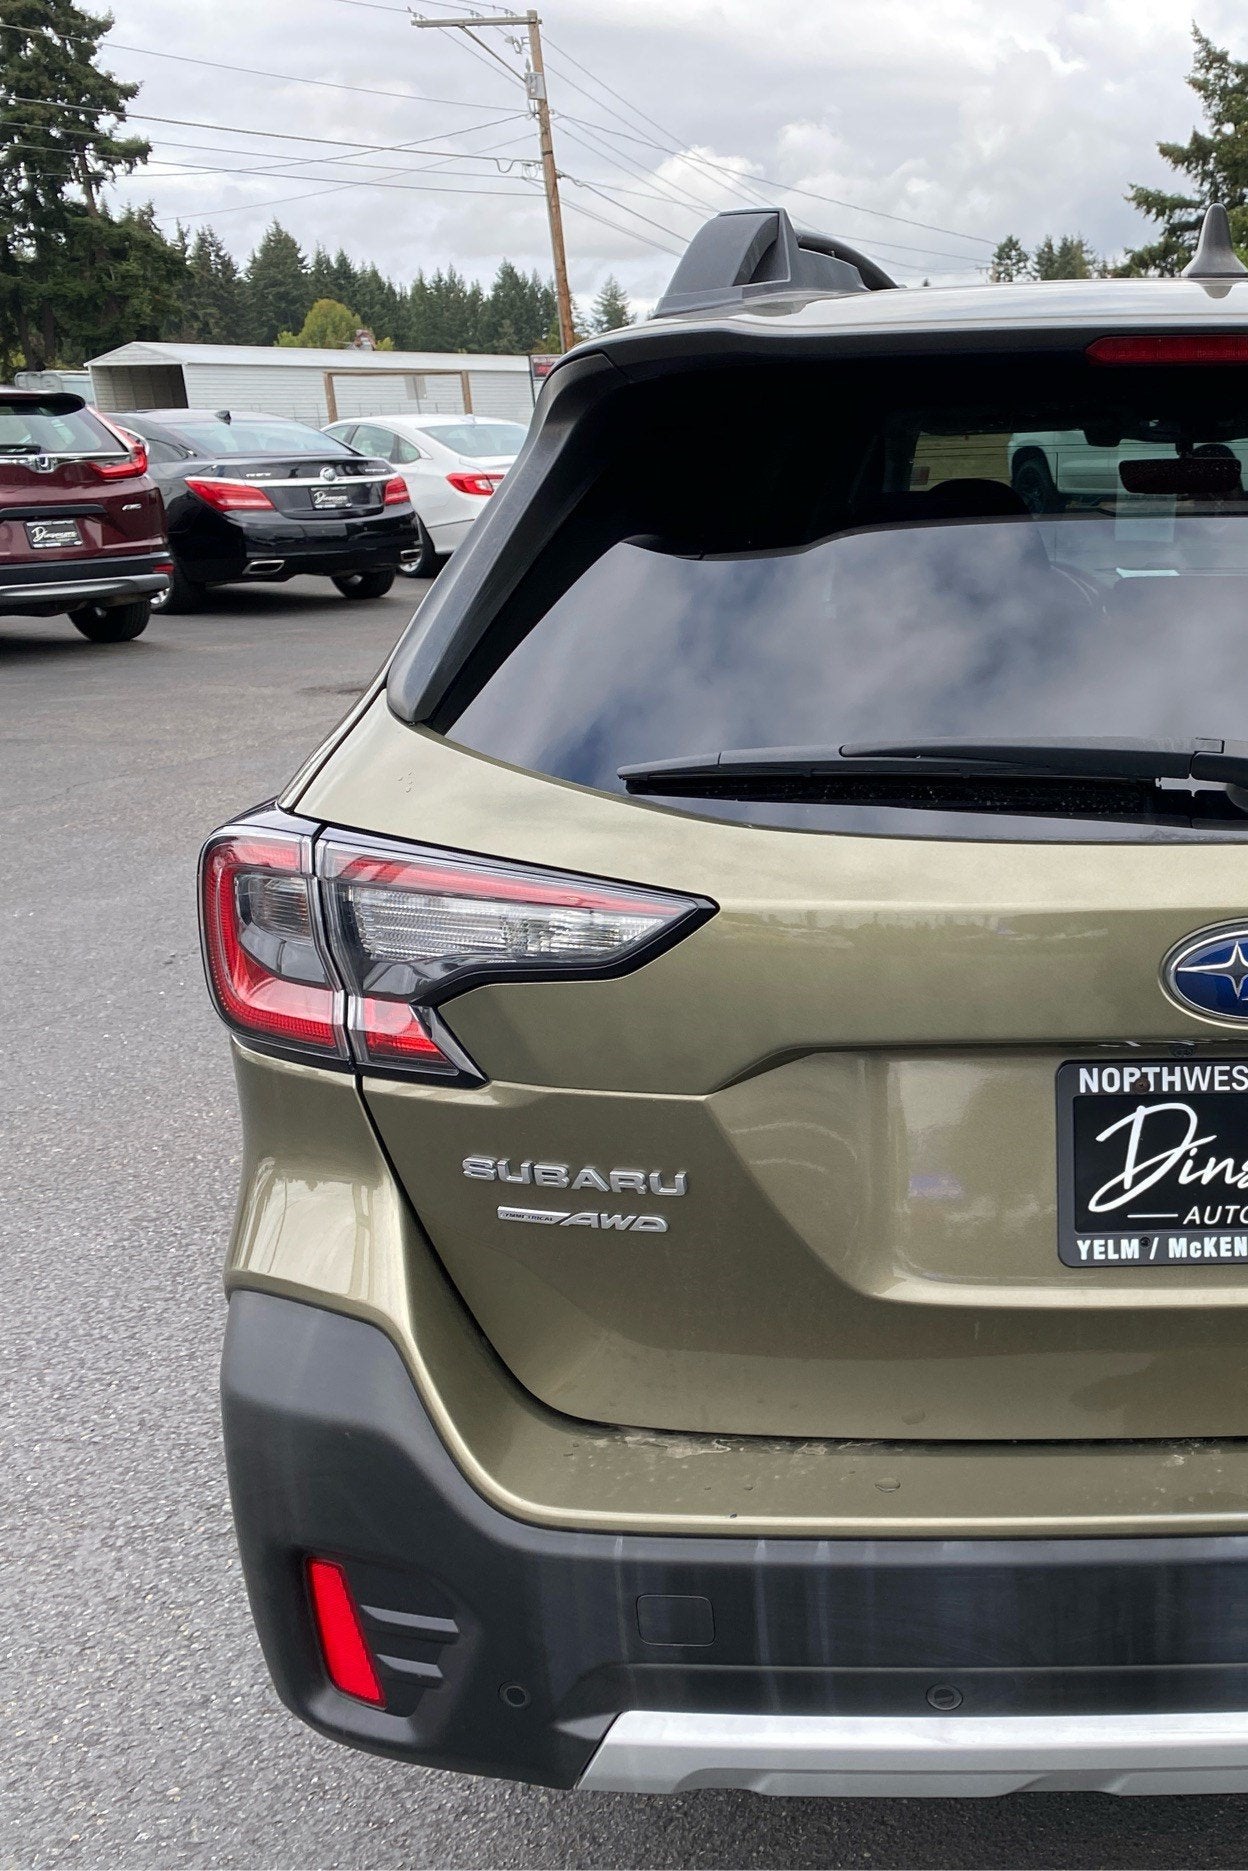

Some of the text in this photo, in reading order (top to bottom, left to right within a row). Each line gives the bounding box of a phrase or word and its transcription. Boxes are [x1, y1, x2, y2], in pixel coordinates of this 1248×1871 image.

[462, 1155, 688, 1196] SUBARU
[560, 1212, 669, 1233] AWD
[1077, 1239, 1139, 1260] YELM
